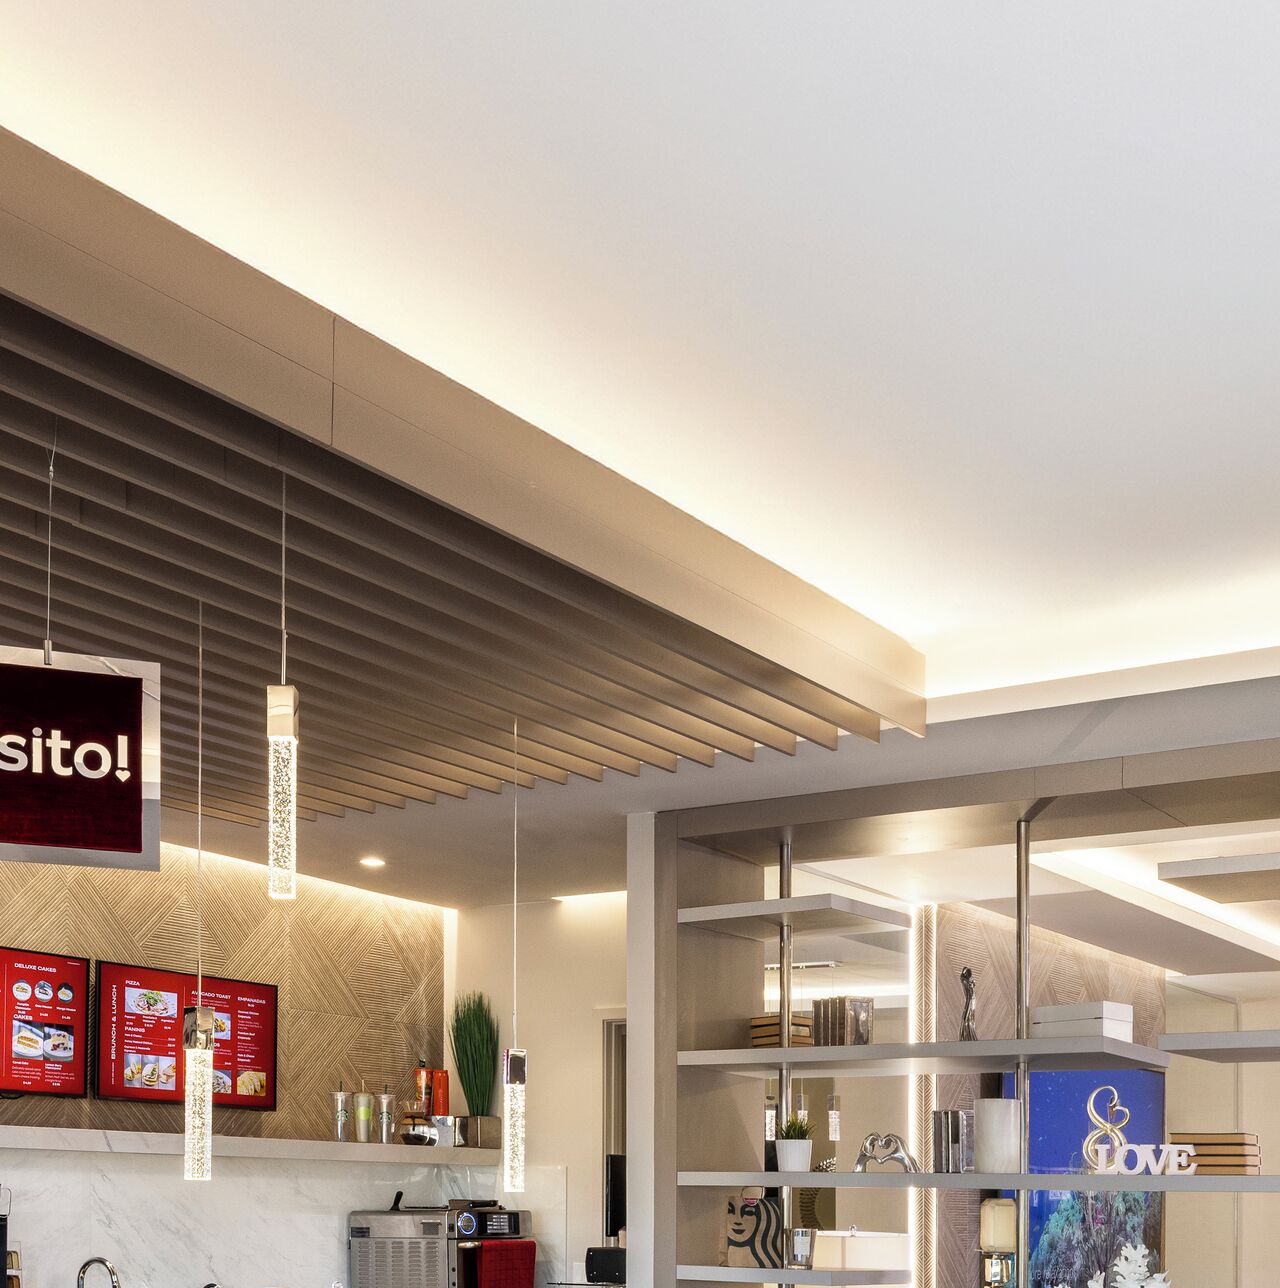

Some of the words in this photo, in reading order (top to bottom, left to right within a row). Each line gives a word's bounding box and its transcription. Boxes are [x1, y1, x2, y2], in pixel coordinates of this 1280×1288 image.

[14, 962, 37, 971] DELUXE
[37, 965, 56, 973] CAKES
[191, 990, 215, 998] AVCADO
[237, 996, 266, 1004] EMPANADAS
[1094, 1144, 1198, 1175] LOVE
